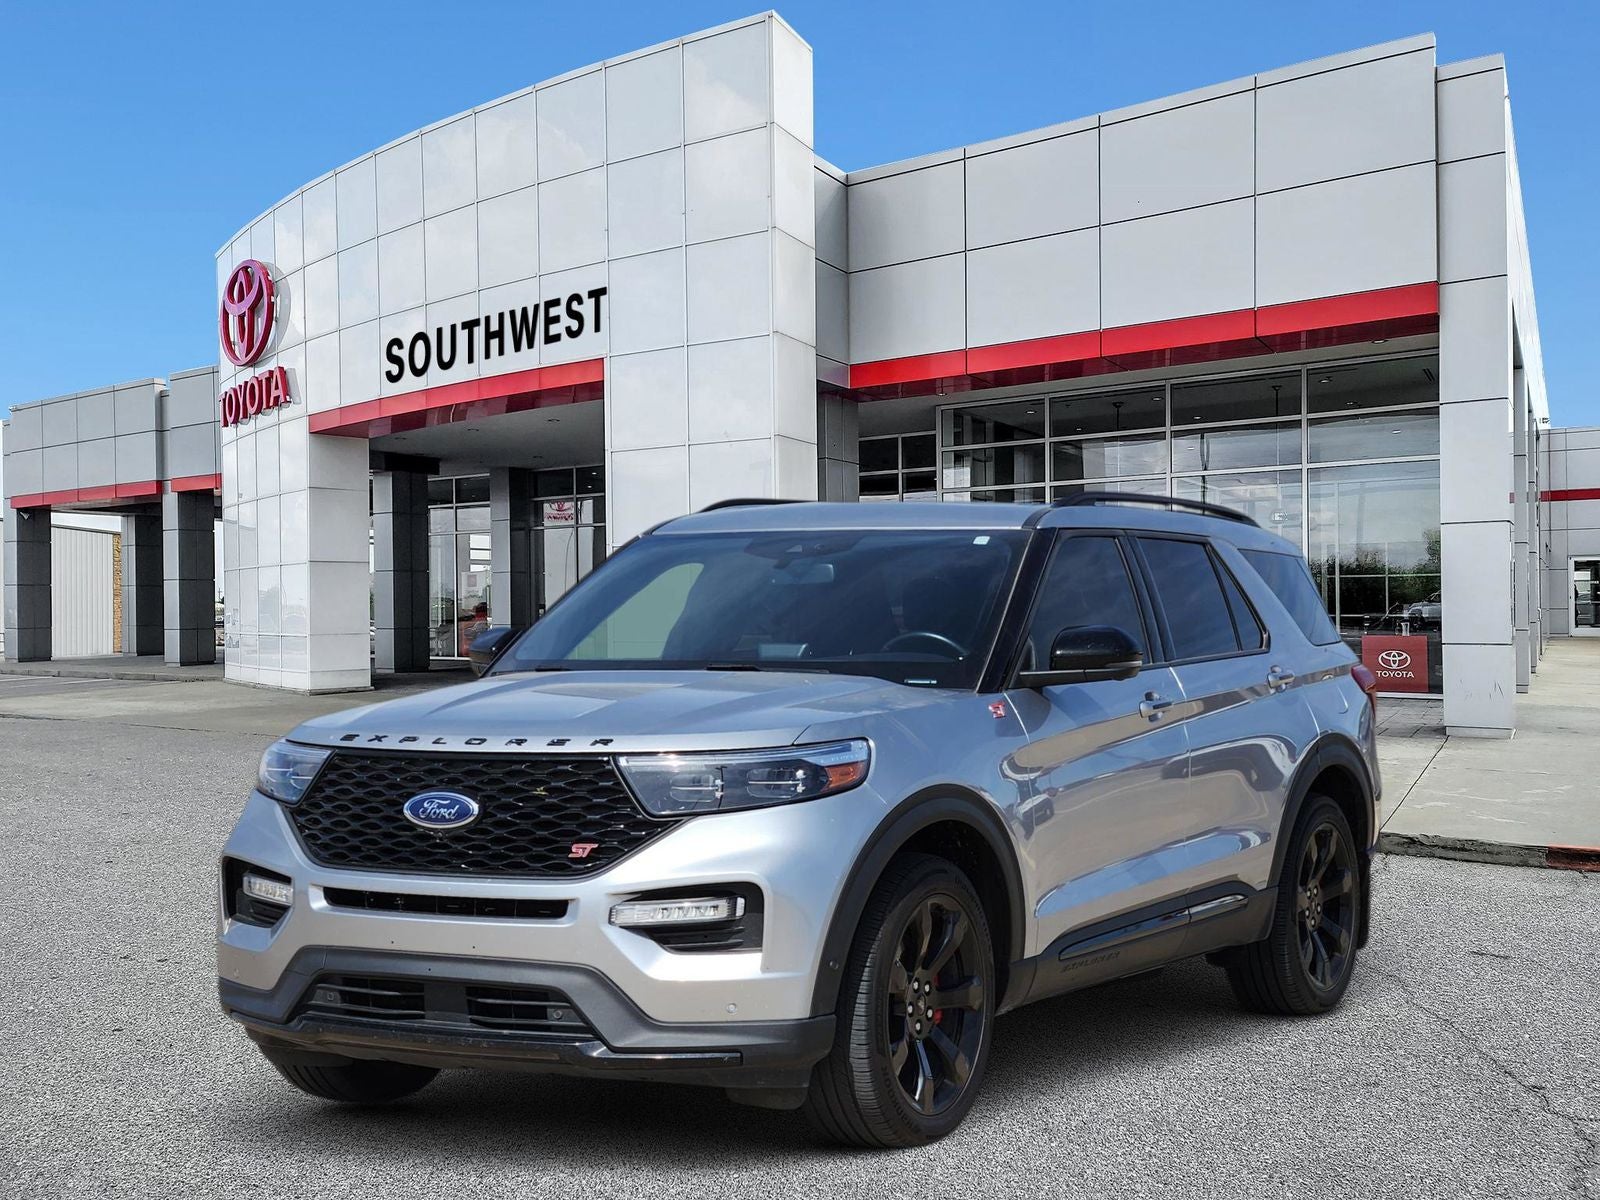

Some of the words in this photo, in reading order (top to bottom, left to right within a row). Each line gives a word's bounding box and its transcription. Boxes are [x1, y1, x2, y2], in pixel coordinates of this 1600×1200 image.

[385, 287, 608, 384] SOUTHWEST
[218, 366, 289, 427] TOYOTA
[1376, 670, 1415, 678] TOYOTA
[339, 734, 614, 747] EXPLORER
[419, 799, 460, 819] Ford
[567, 843, 599, 858] ST
